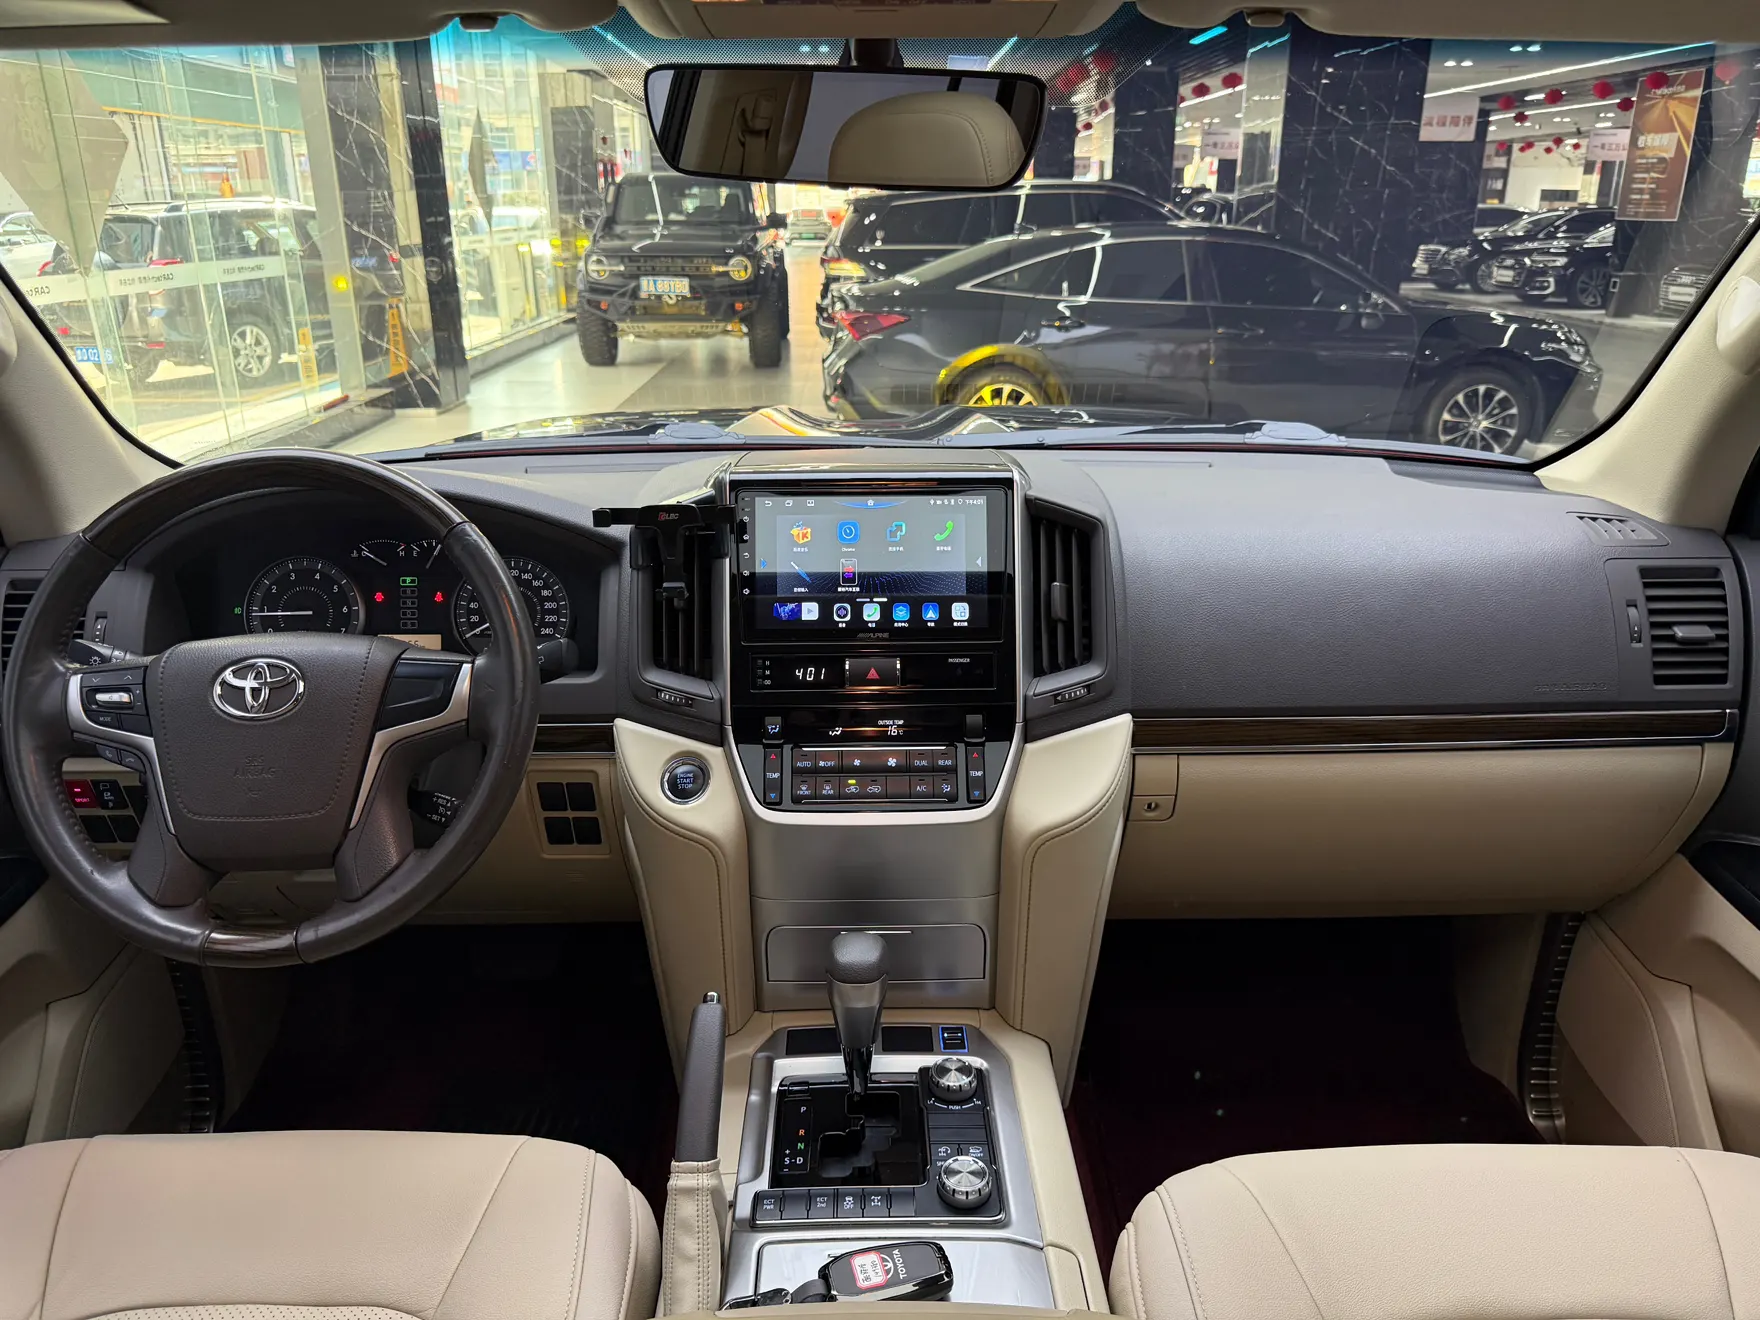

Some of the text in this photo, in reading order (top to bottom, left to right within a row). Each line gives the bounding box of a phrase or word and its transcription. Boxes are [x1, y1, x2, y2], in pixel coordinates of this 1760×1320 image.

[271, 585, 277, 593] 2
[333, 585, 339, 593] 5
[342, 605, 348, 613] 6
[797, 1142, 805, 1150] N
[892, 1248, 908, 1280] TOYOTA
